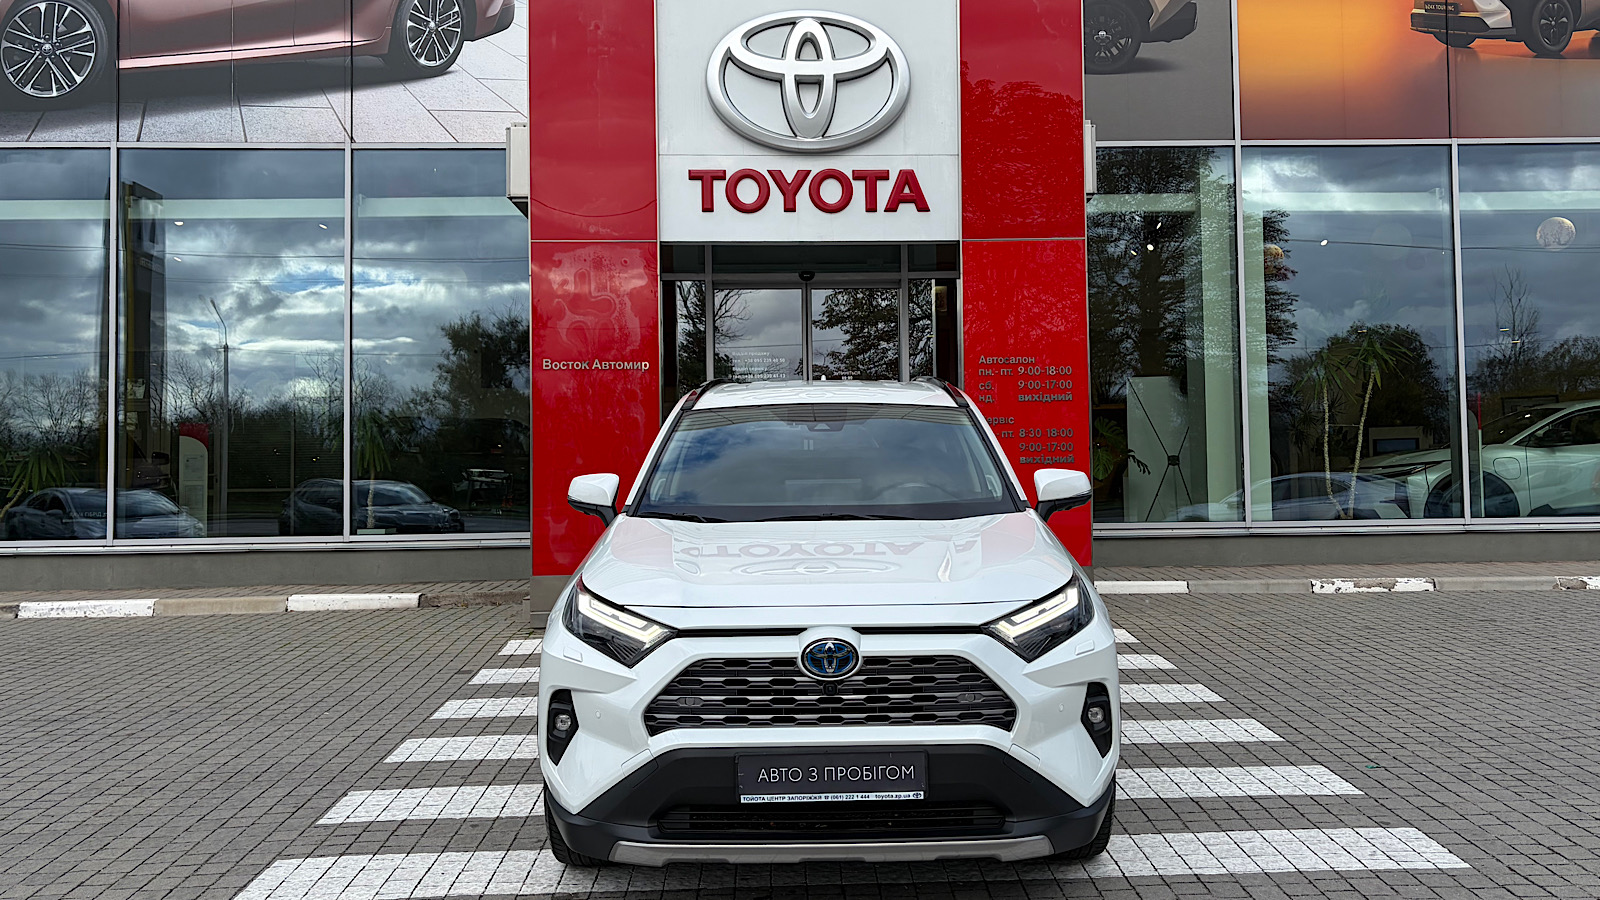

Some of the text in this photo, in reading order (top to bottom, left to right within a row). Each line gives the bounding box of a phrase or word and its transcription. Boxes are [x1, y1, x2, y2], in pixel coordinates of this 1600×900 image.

[688, 168, 931, 214] TOYOTA
[978, 355, 1035, 364] Автосалон
[542, 358, 650, 372] Восток Автомир
[978, 381, 995, 390] сб.
[978, 392, 1073, 404] нд. вихідний
[985, 416, 1015, 426] ервіс
[1018, 442, 1074, 452] 9:00-17:00
[1019, 454, 1075, 464] вихідний
[757, 767, 803, 783] АВТО
[823, 765, 915, 781] ПРОБІГОМ
